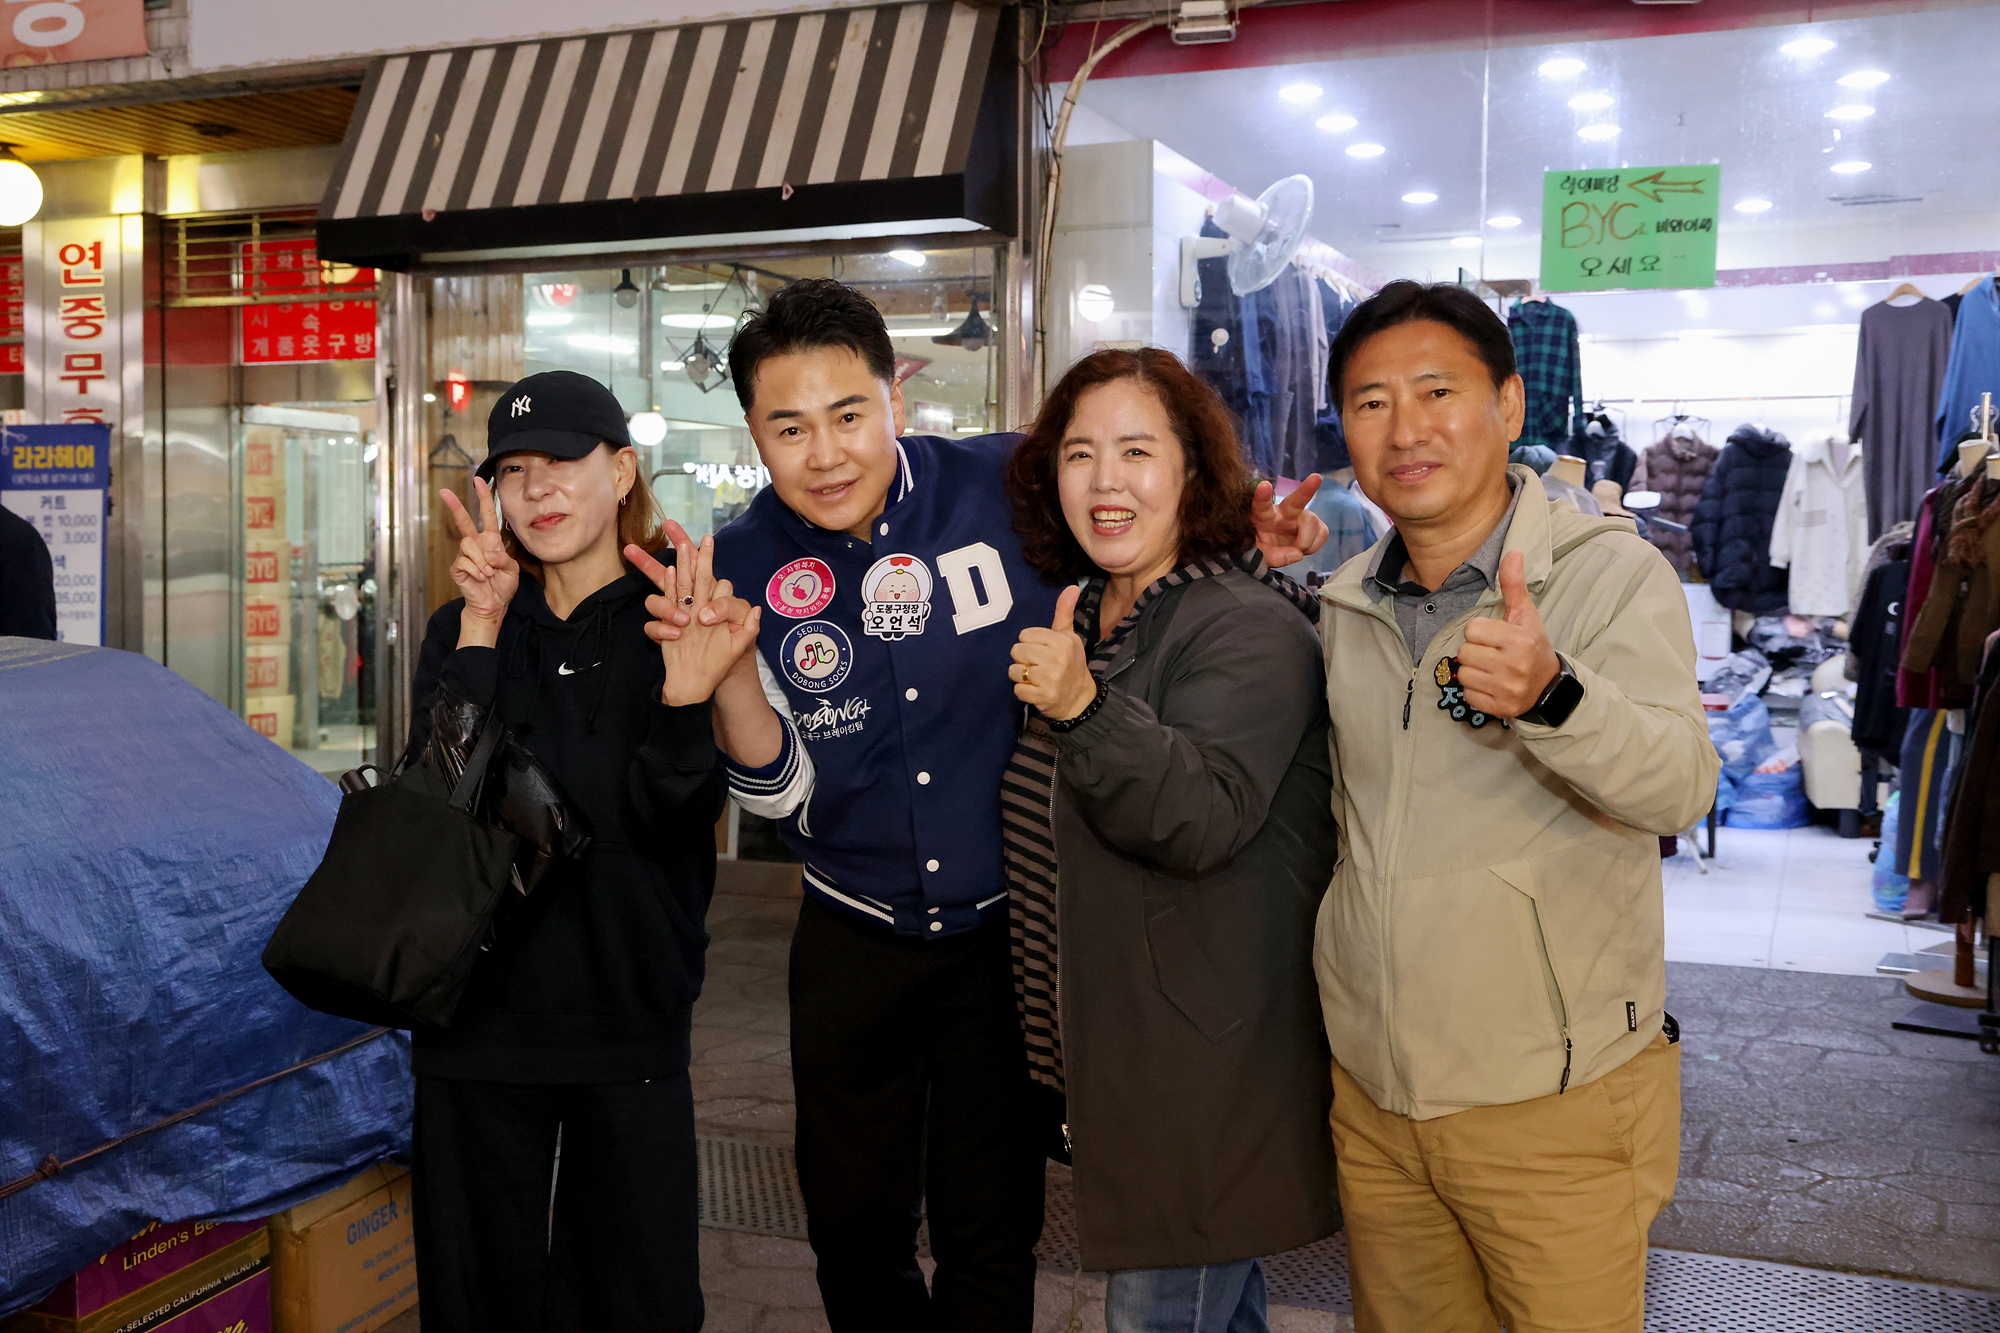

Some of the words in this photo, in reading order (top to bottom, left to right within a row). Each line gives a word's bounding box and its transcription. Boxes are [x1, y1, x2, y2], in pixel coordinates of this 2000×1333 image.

[1579, 256, 1662, 278] 오세요
[511, 394, 532, 418] NY
[13, 445, 95, 469] 라라헤어
[58, 514, 97, 527] 10,000
[245, 556, 276, 580] BYC
[936, 542, 1013, 635] D
[245, 610, 277, 632] BYC
[875, 604, 920, 615] 도봉구청장
[796, 625, 824, 638] SEOUL
[791, 671, 827, 689] DOBONG
[828, 660, 848, 685] SOCKS
[823, 720, 864, 740] 브레이킹팀
[347, 1201, 399, 1245] GINGER
[123, 1230, 189, 1271] Linden's
[172, 1277, 222, 1308] CALIFORNIA
[223, 1258, 261, 1282] WALNUTS
